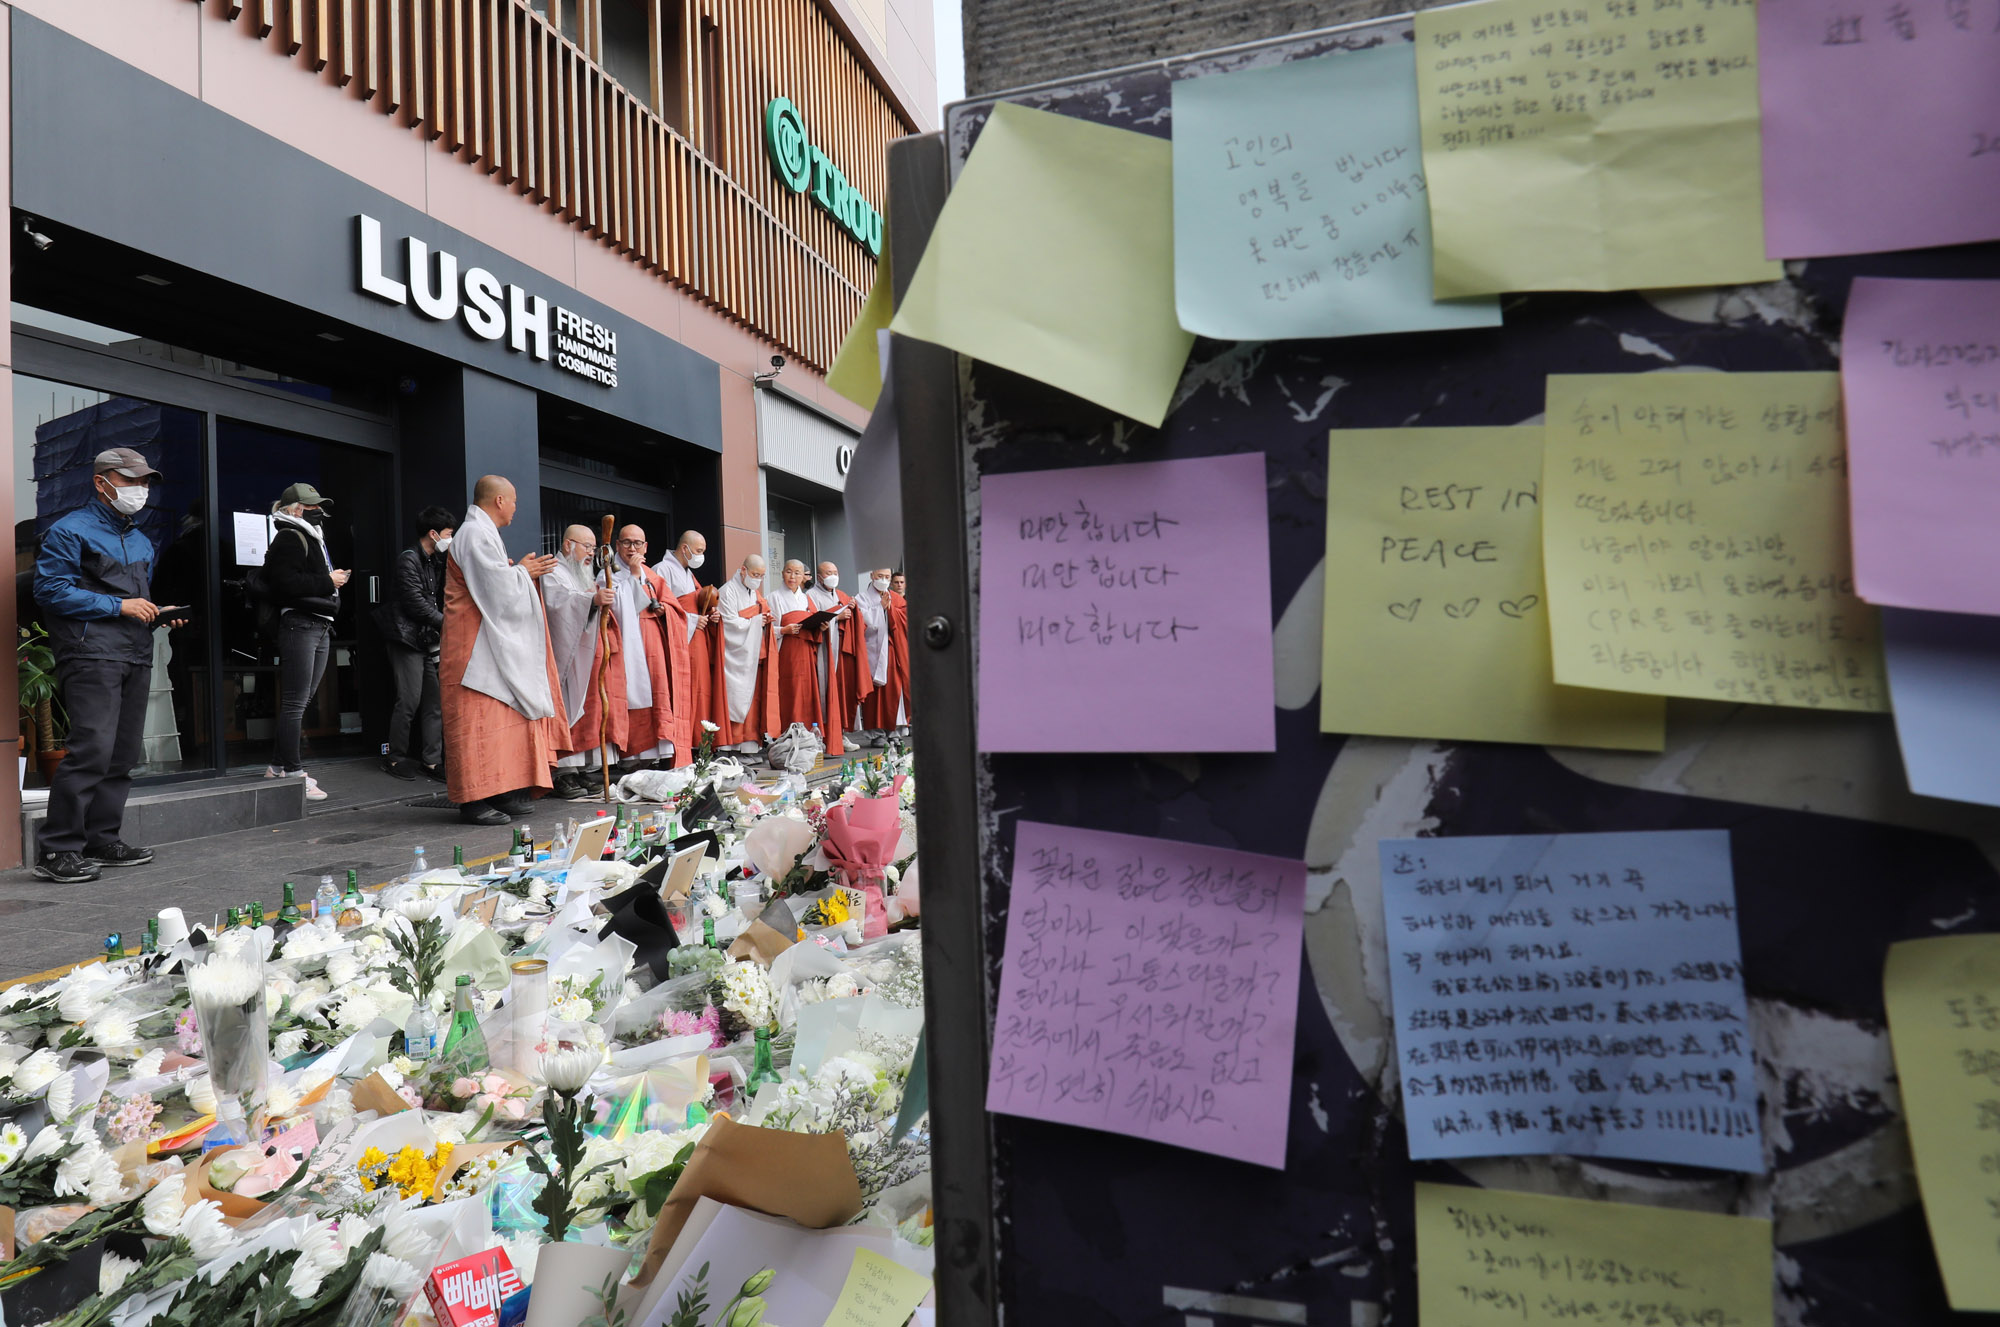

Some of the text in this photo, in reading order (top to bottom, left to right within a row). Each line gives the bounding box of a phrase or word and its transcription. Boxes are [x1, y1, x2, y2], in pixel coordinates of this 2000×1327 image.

[1223, 132, 1292, 170] 고인의
[1335, 147, 1408, 183] 빕니다
[809, 144, 883, 256] TROU
[357, 214, 549, 361] LUSH
[556, 306, 617, 354] FRESH
[557, 333, 617, 372] HANDMADE
[557, 352, 618, 388] COSMETICS
[1572, 456, 1616, 482] 저는
[1400, 481, 1538, 511] REST IN
[1381, 536, 1498, 569] PEACE
[1116, 856, 1171, 903] 젊은
[1021, 899, 1104, 943] 얼마나
[1017, 943, 1097, 981] 얼마나
[442, 1263, 460, 1273] LOTTE
[442, 1268, 520, 1311] 빼빼로
